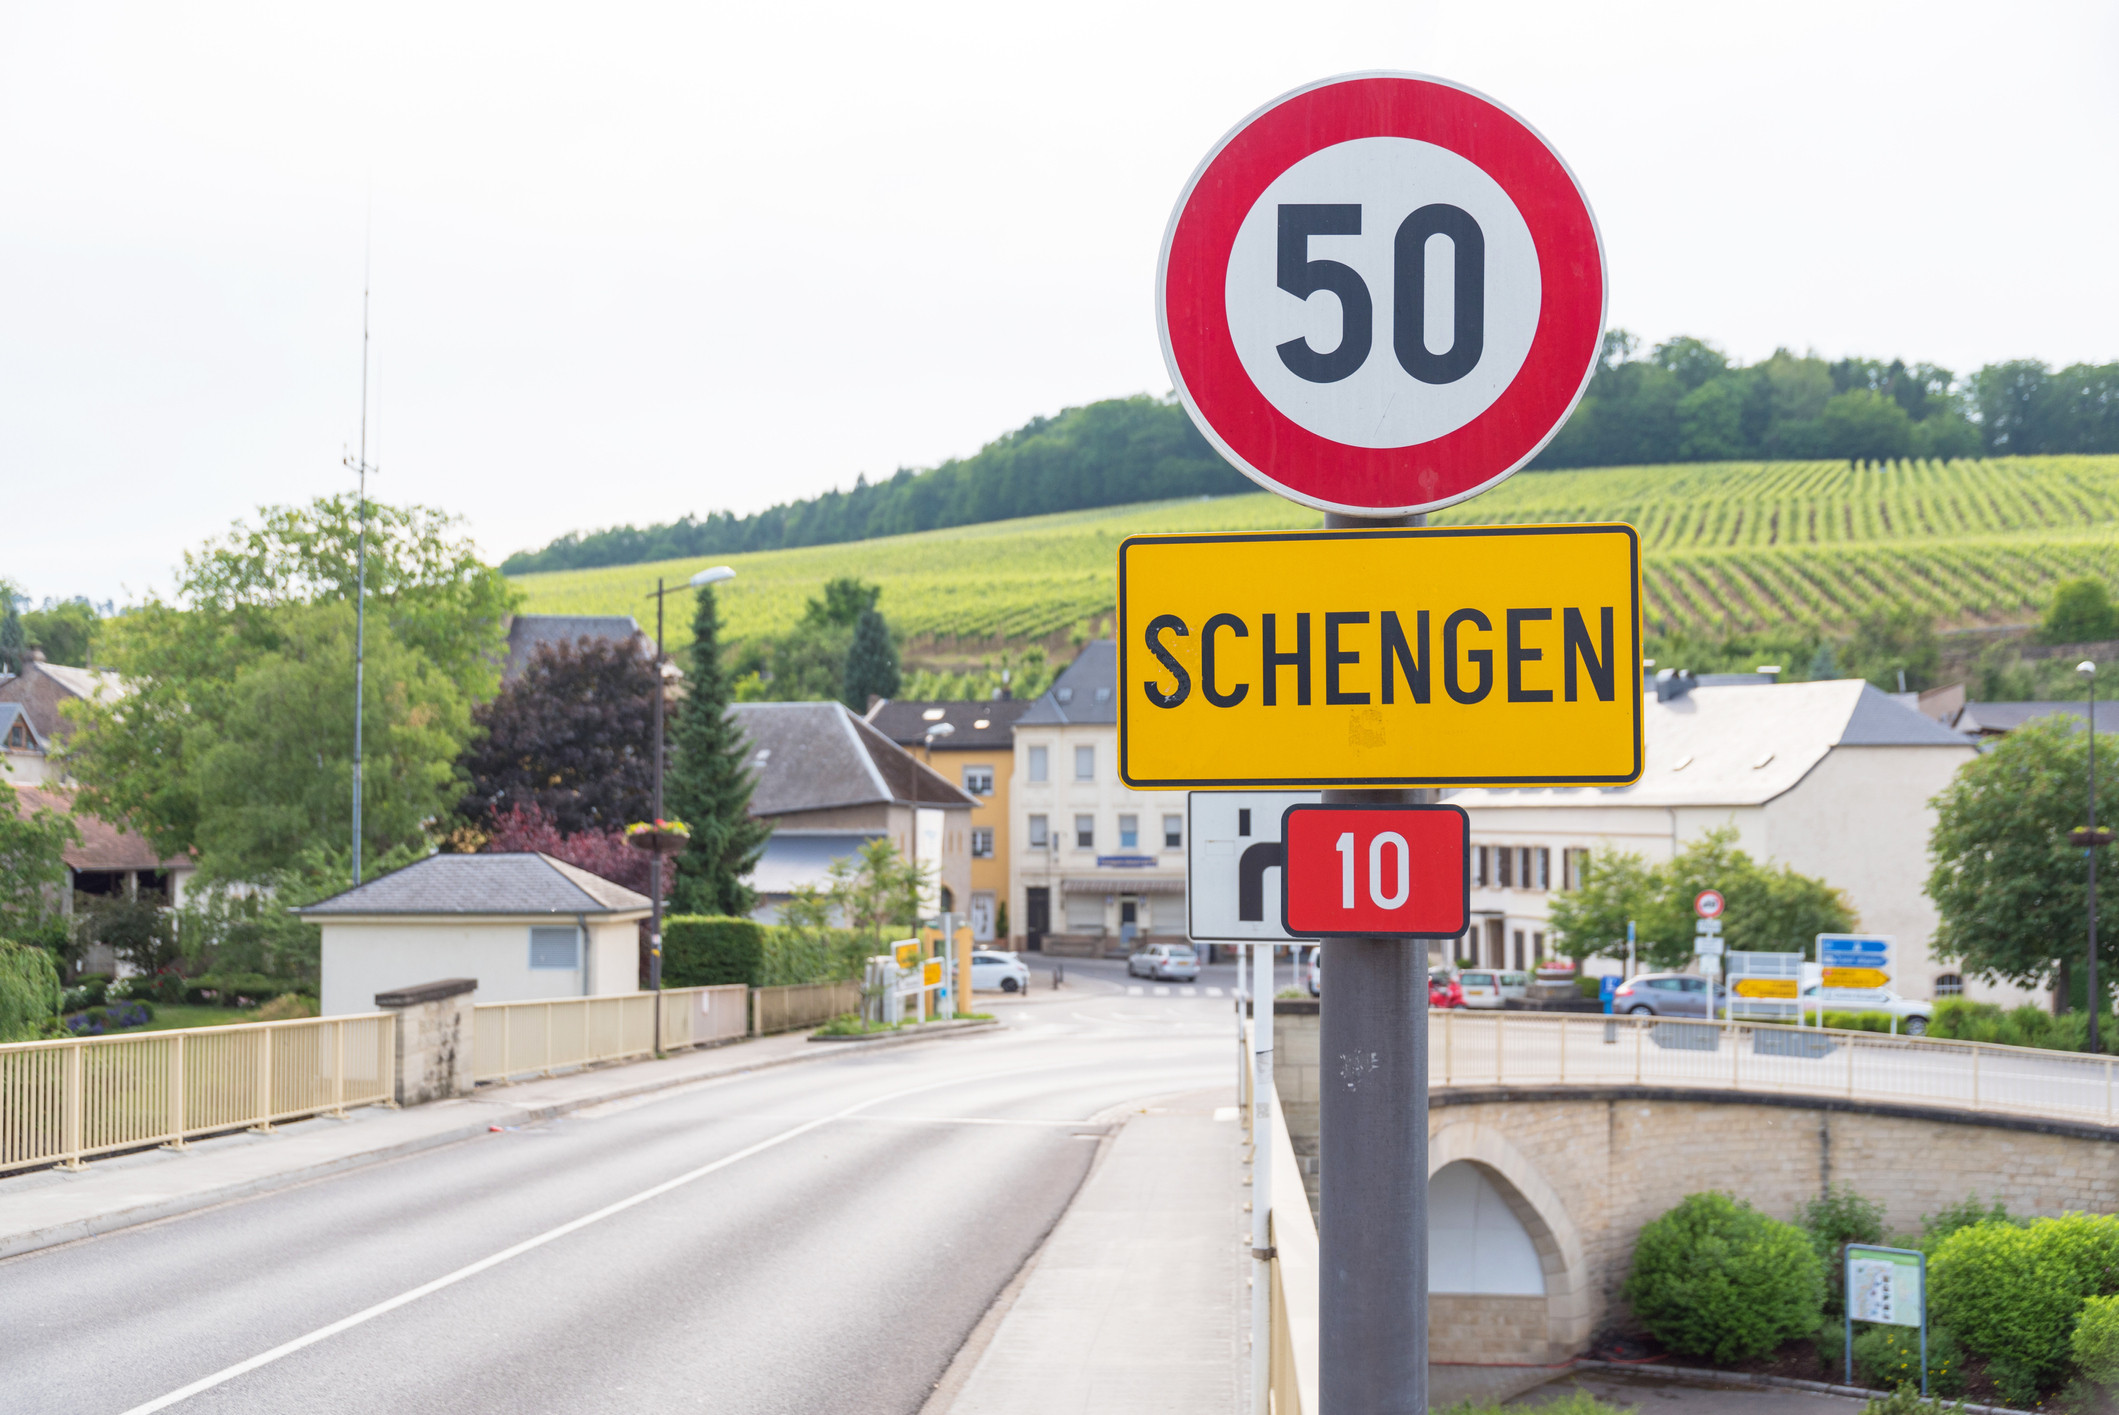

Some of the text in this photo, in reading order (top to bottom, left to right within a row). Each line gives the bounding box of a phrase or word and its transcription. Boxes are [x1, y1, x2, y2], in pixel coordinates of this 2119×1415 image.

[1275, 203, 1485, 385] 50
[1143, 606, 1615, 709] SCHENGEN
[1335, 831, 1411, 910] 10
